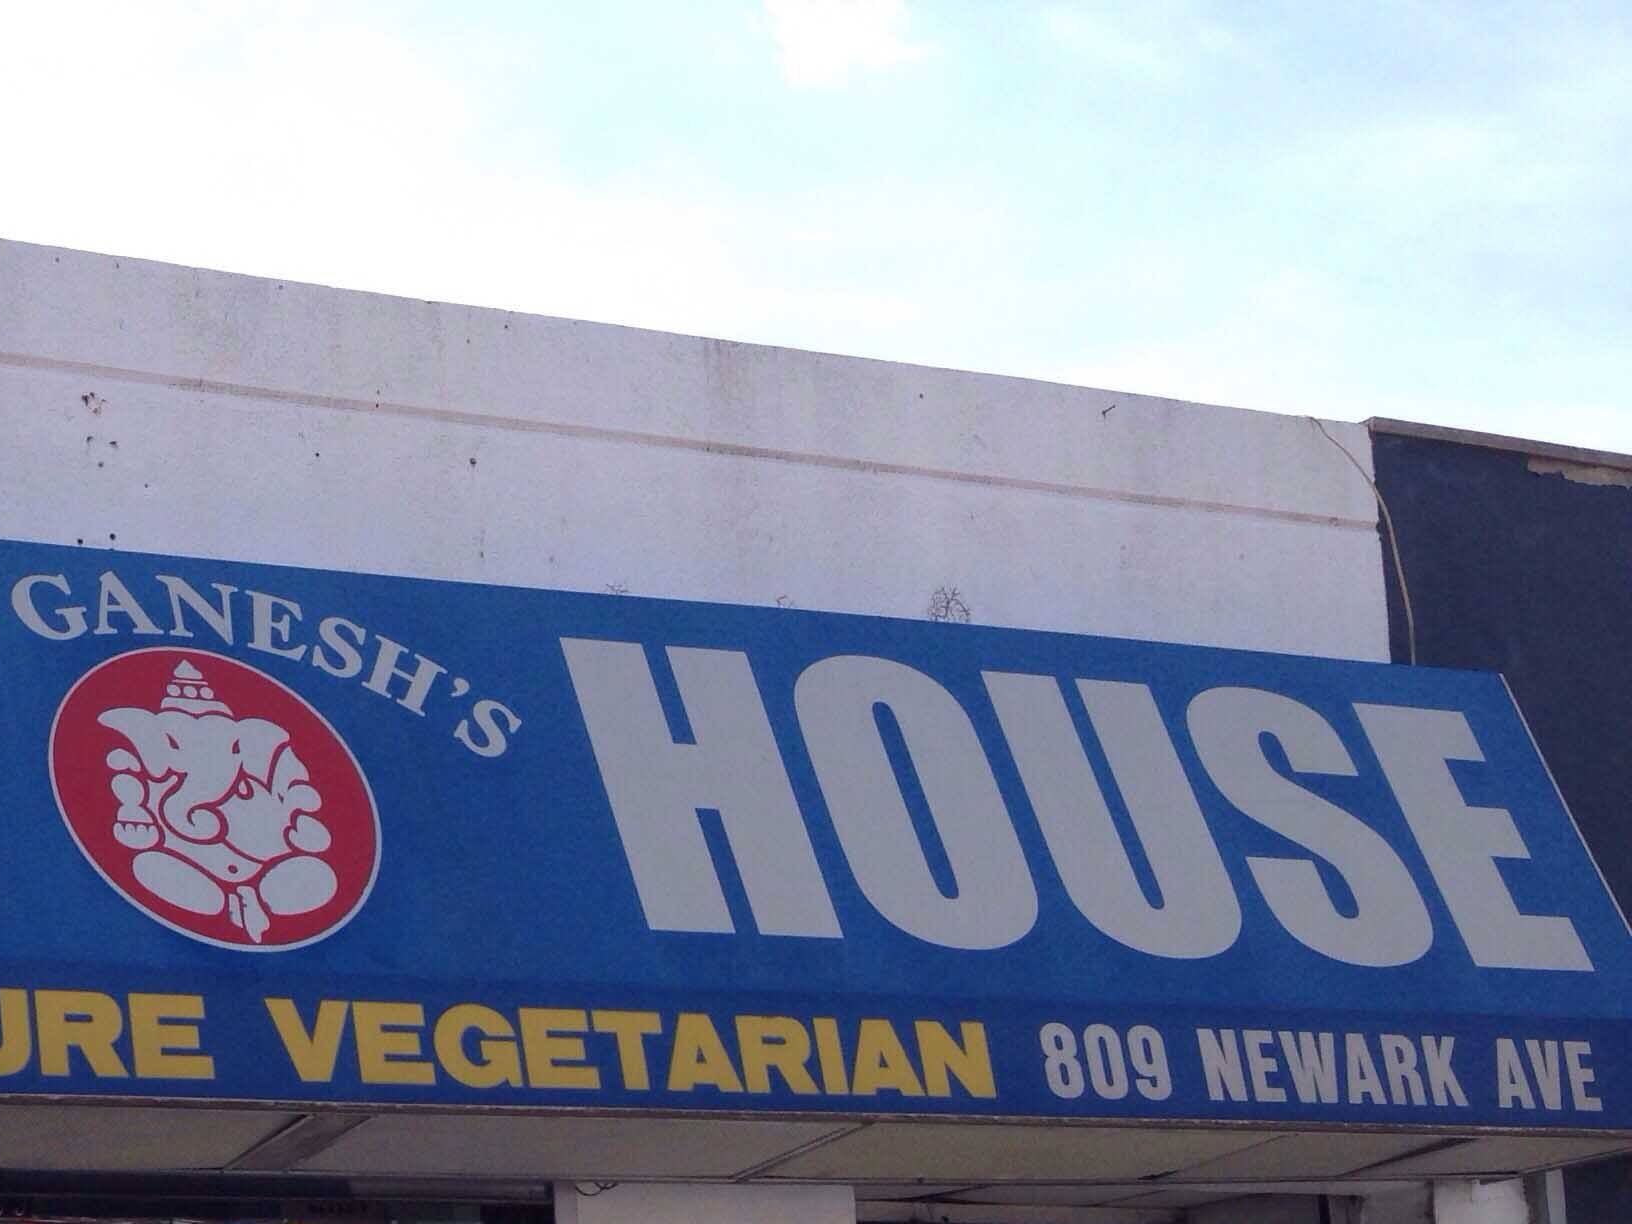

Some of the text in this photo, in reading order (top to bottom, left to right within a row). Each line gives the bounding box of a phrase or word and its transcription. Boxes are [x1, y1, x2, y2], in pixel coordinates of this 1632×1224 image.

[11, 571, 522, 758] GANESH'S
[559, 637, 1595, 972] HOUSE
[264, 997, 997, 1099] VEGETARIAN
[1039, 1022, 1604, 1112] 809 NEWARK AVE
